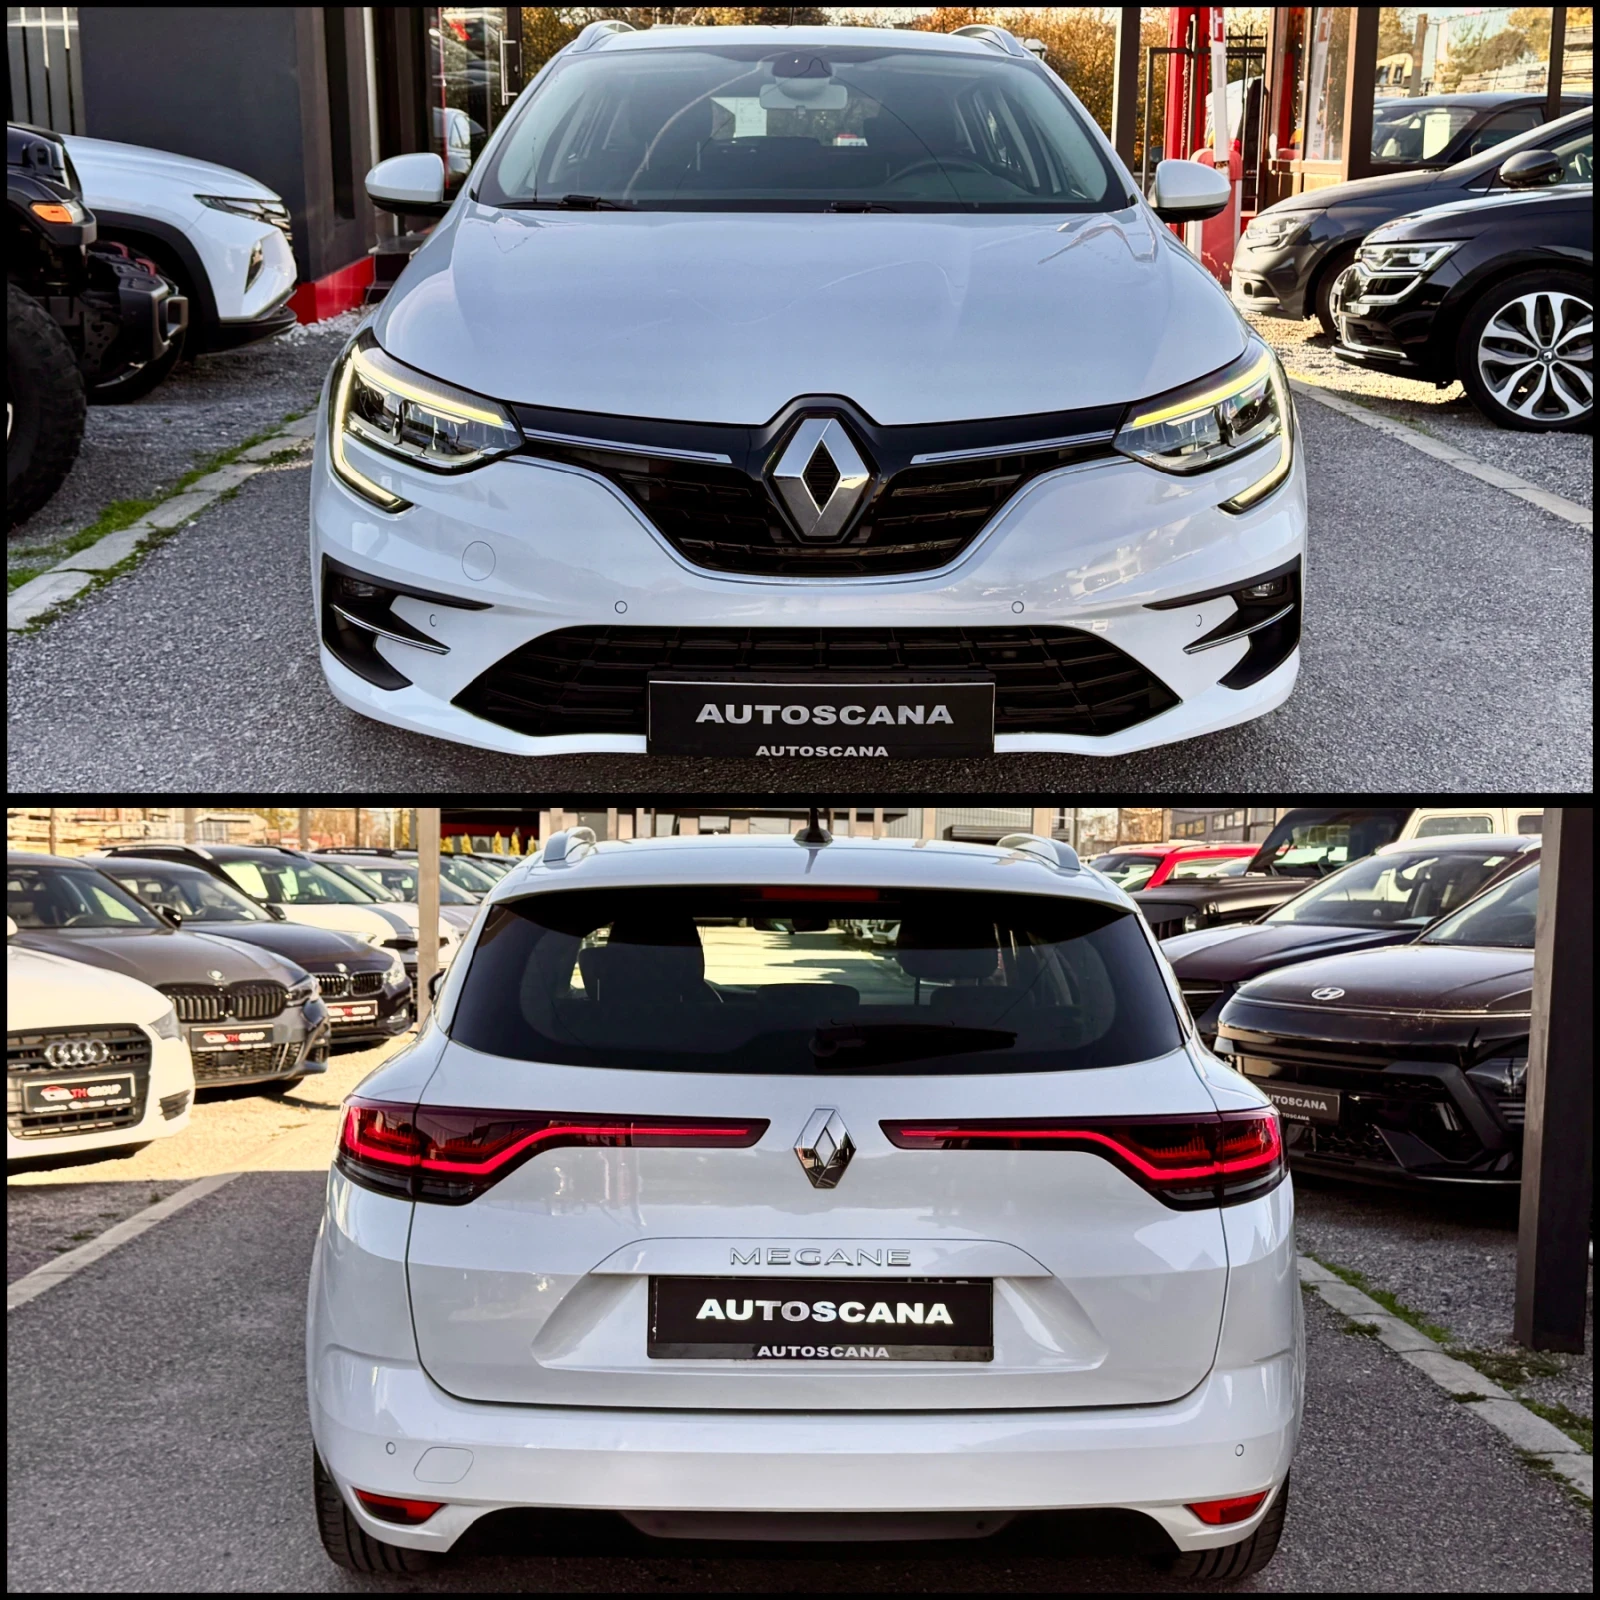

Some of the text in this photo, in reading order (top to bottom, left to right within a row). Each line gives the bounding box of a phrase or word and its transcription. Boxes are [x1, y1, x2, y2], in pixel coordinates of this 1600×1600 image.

[695, 703, 954, 725] AUTOSCANA
[755, 745, 889, 757] AUTOSCANA
[1266, 1093, 1327, 1111] UTOSCANA
[1282, 1112, 1310, 1121] TOSCANA
[730, 1247, 911, 1267] MEGANE
[696, 1298, 953, 1325] AUTOSCANA
[756, 1345, 890, 1358] AUTOSCANA
